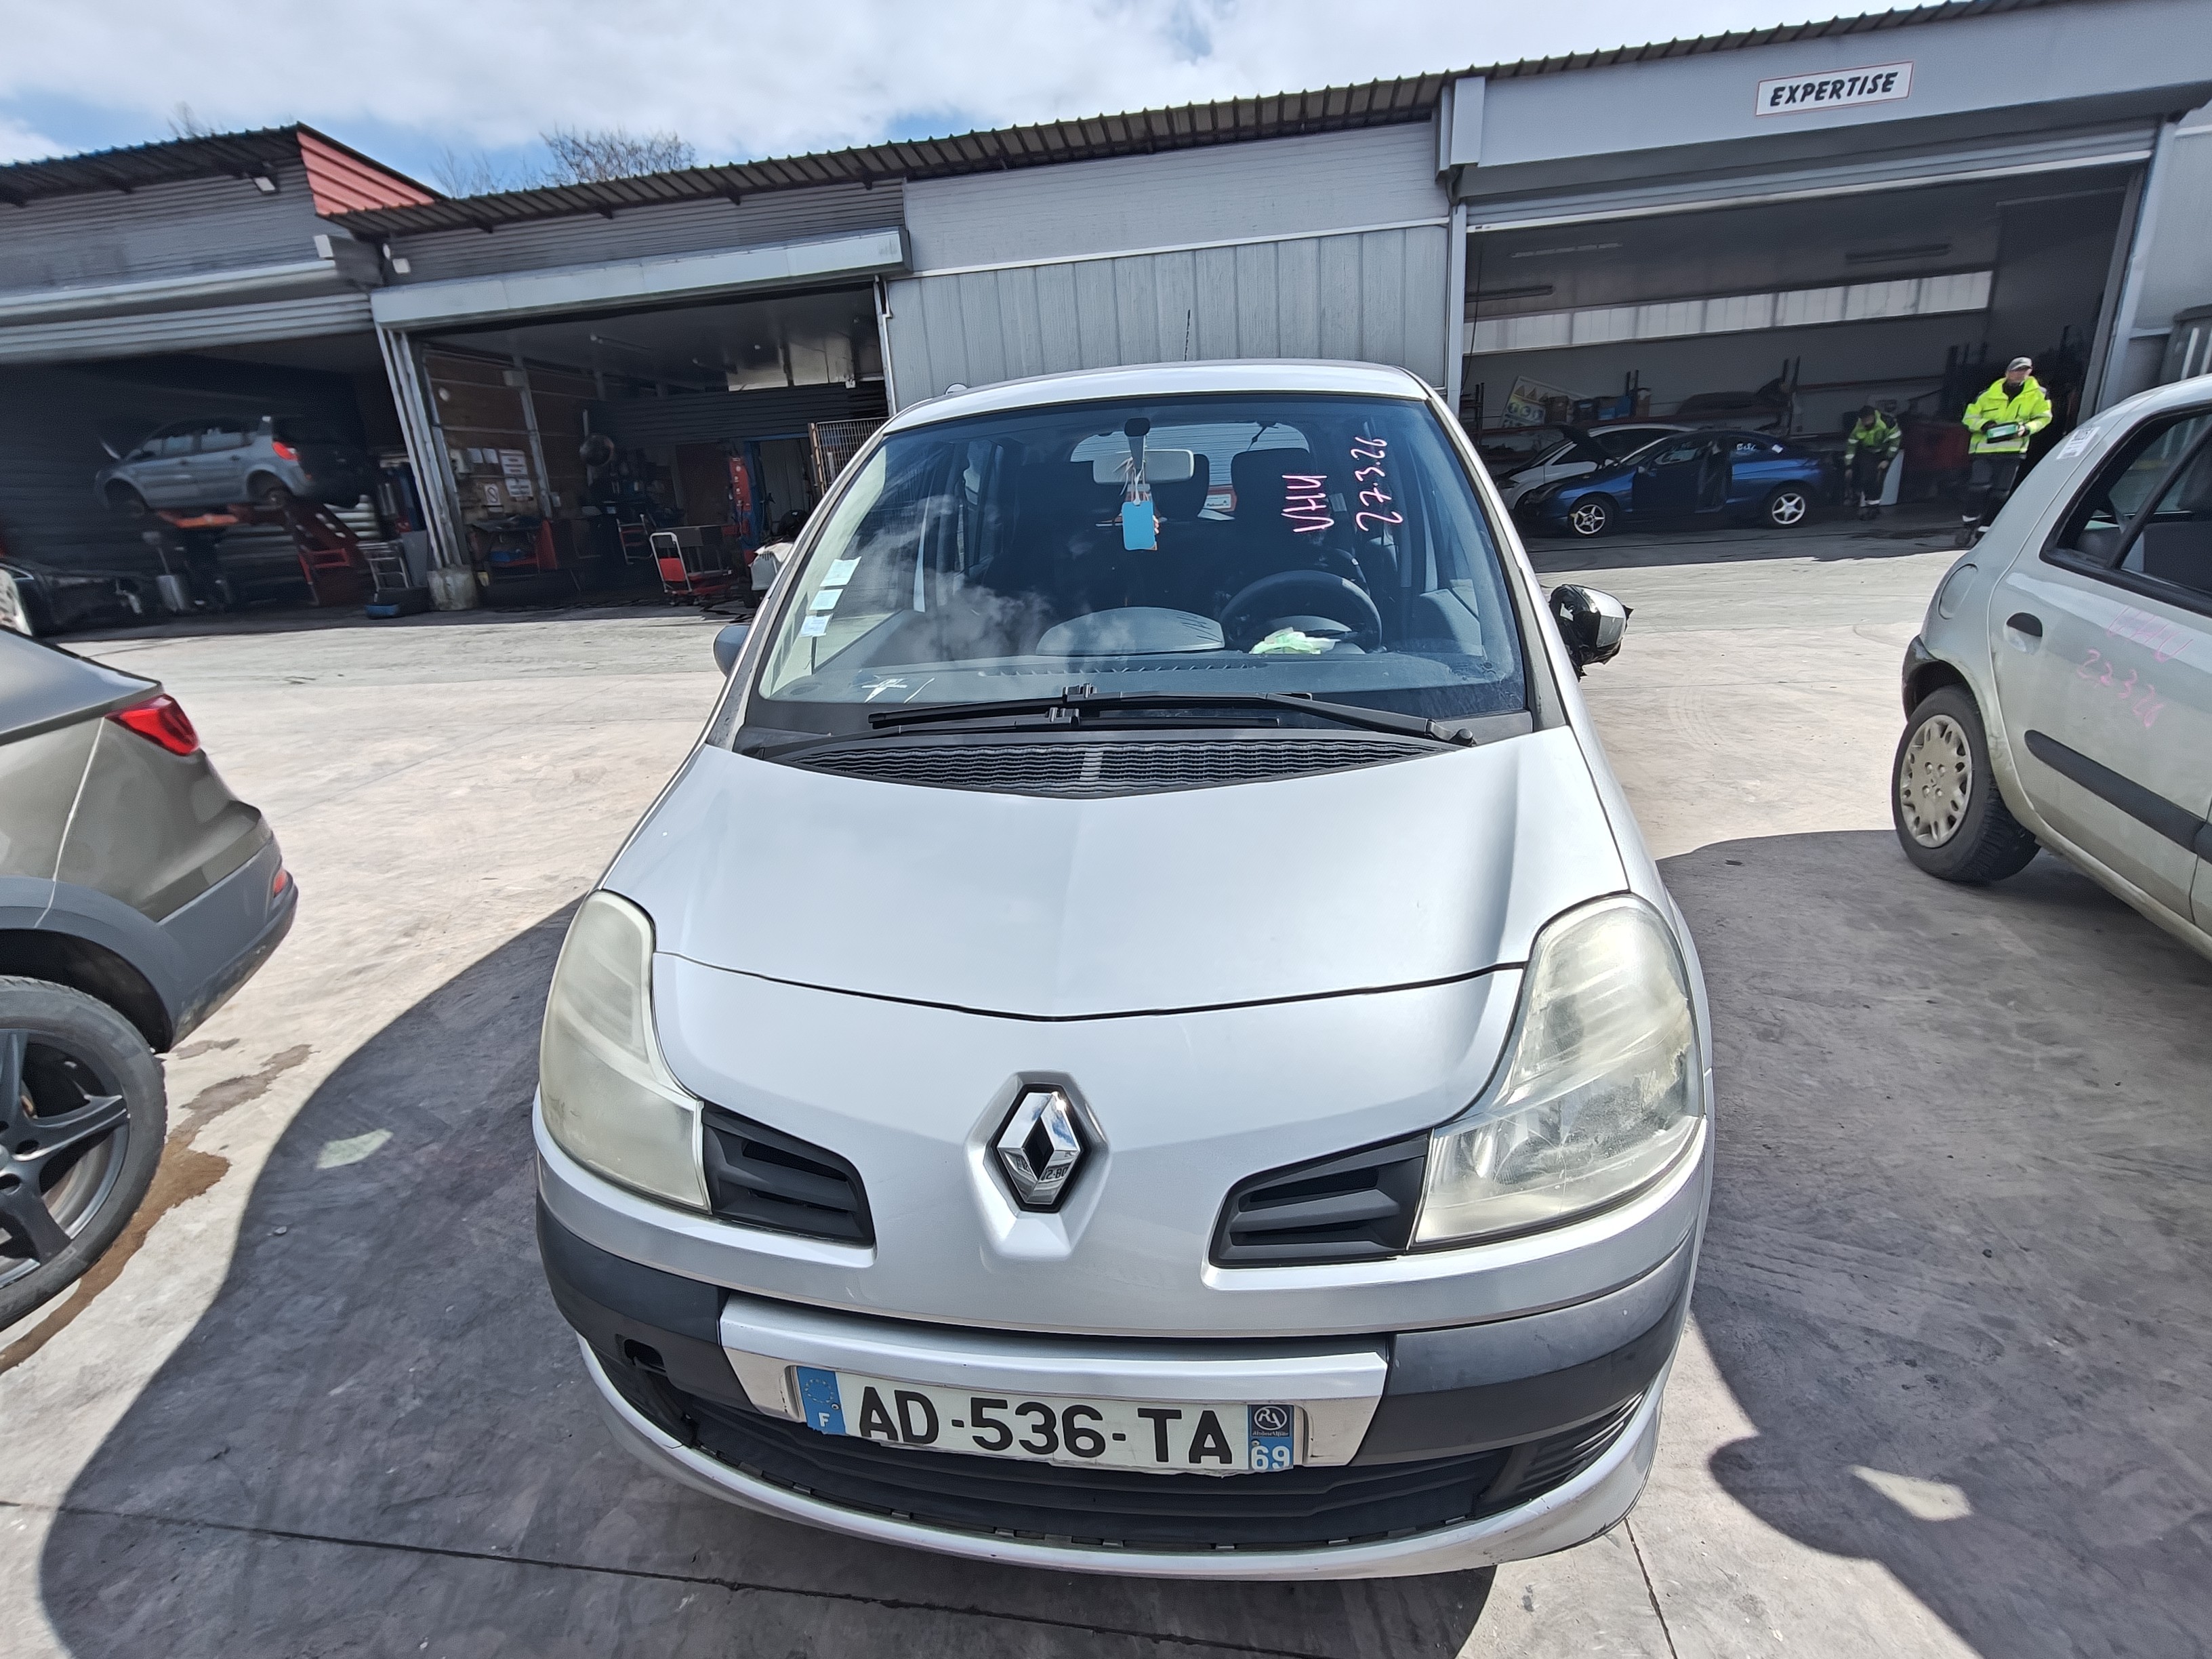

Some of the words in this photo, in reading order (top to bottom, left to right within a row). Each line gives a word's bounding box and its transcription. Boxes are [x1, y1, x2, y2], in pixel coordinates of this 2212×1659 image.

[1769, 72, 1898, 106] EXPERTISE
[818, 1412, 830, 1427] F
[859, 1386, 1233, 1465] AD-536-TA
[1250, 1446, 1290, 1471] 69
